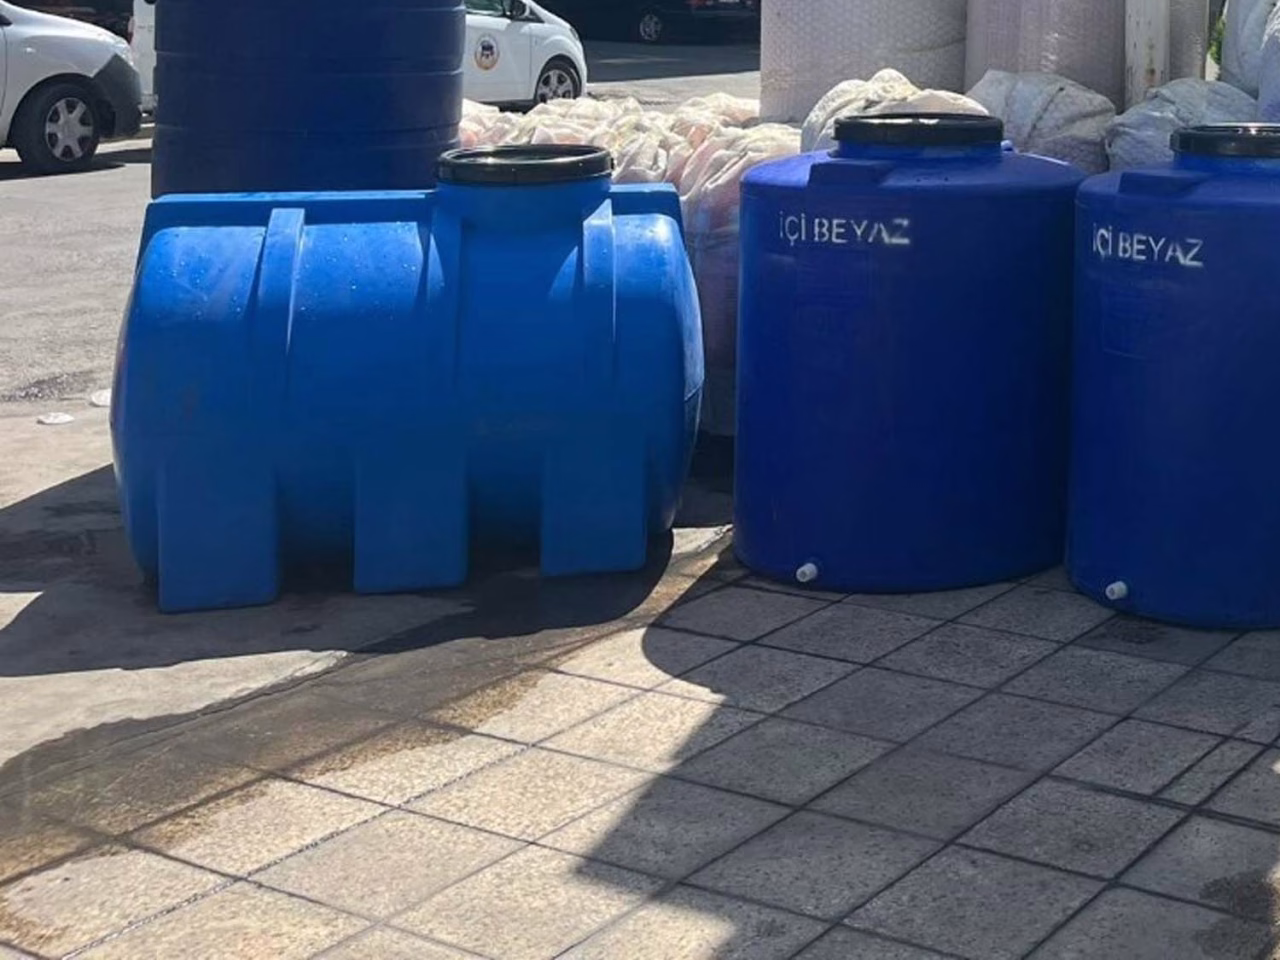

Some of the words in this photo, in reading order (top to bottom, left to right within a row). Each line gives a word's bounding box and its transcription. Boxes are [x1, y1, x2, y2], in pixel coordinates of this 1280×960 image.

[779, 210, 806, 247] İÇİ
[814, 217, 911, 245] BEYAZ
[1118, 232, 1204, 267] BEYAZ
